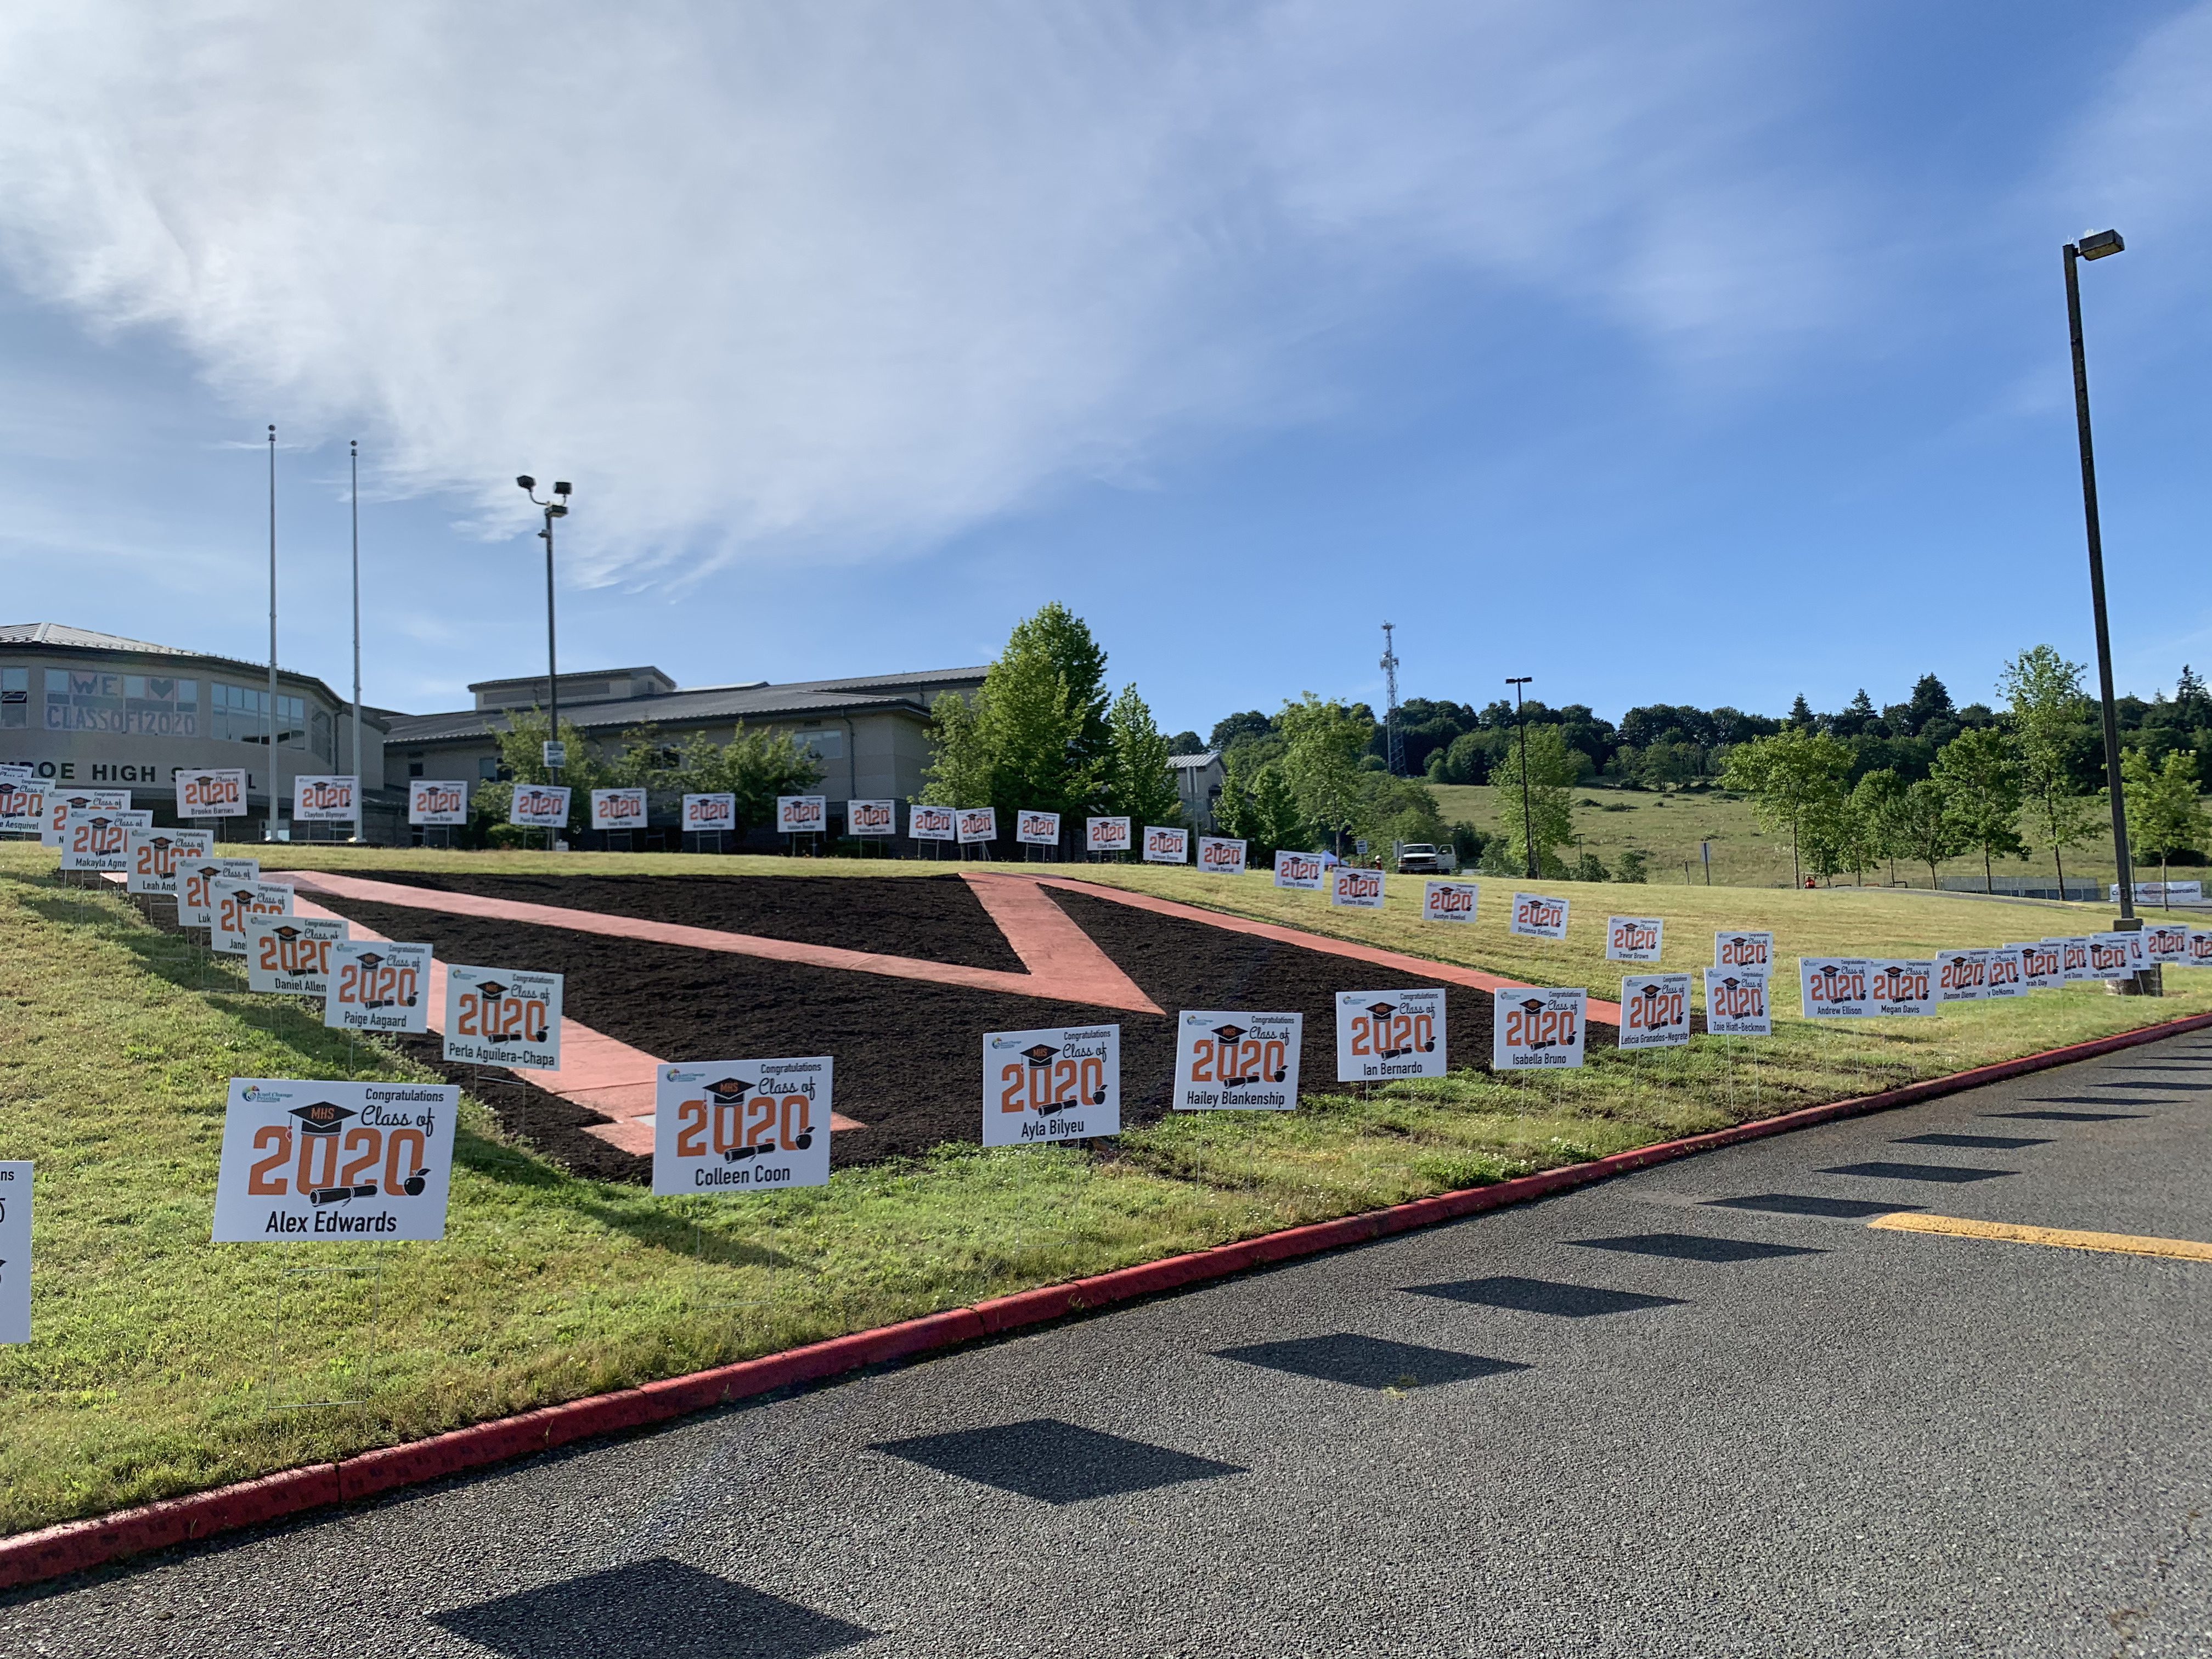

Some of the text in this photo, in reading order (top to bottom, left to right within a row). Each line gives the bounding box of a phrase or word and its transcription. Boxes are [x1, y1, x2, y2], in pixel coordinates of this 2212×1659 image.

[73, 672, 119, 695] WE
[92, 763, 155, 782] HIGH
[185, 782, 236, 804] 2020
[302, 788, 350, 808] 2020
[114, 799, 122, 809] of
[417, 793, 459, 812] 2020
[518, 796, 562, 815] 2020
[599, 800, 641, 818] 2020
[690, 804, 727, 820] 2020
[783, 805, 820, 822] 2020
[854, 809, 889, 825] 2020
[5, 820, 38, 830] Aesquivel
[114, 819, 134, 827] Class
[915, 815, 950, 831] 2020
[962, 817, 991, 833] 2020
[1023, 820, 1054, 835] 2020
[73, 826, 128, 853] 202
[1092, 826, 1125, 841] 2020
[175, 838, 205, 852] Class of
[1149, 837, 1182, 853] 2020
[76, 858, 106, 868] Makayla
[1204, 847, 1240, 865] 2020
[223, 868, 251, 880] Class of
[1280, 861, 1318, 880] 2020
[143, 881, 160, 891] Leah
[1339, 879, 1378, 898] 2020
[257, 893, 285, 910] Class of
[1430, 892, 1471, 911] 2020
[1518, 905, 1561, 928] 2020
[304, 928, 339, 940] Class of
[1614, 929, 1655, 950] 2020
[1762, 938, 1768, 947] of
[2148, 935, 2184, 953] 2020
[1723, 945, 1765, 964] 2020
[387, 954, 421, 974] Class of
[1841, 966, 1865, 978] Class of
[1905, 967, 1930, 979] Class of
[1940, 963, 1984, 988] 2020
[275, 978, 326, 992] Daniel Allen
[338, 964, 417, 1007] 2020
[1662, 984, 1685, 997] Class of
[1741, 978, 1763, 992] Class of
[1810, 975, 1864, 1001] 2020
[1873, 975, 1928, 1001] 2020
[511, 984, 551, 1006] Class of
[1400, 992, 1438, 1001] Congratulations
[1714, 987, 1761, 1016] 2020
[1944, 991, 1960, 1000] Damon
[1399, 1002, 1435, 1019] Class of
[1547, 1000, 1578, 1015] Class of
[1629, 994, 1683, 1029] 2020
[1817, 1006, 1862, 1015] Andrew Ellison
[1881, 1005, 1901, 1015] Megan
[345, 1011, 407, 1029] Paige Aagaard
[459, 994, 545, 1042] 2020
[1251, 1015, 1294, 1025] Congratulations
[1713, 1022, 1724, 1031] Zoie
[1064, 1030, 1111, 1042] Congratulations
[1249, 1026, 1290, 1046] Class of
[1351, 1015, 1432, 1056] 2020
[1506, 1011, 1575, 1046] 2020
[1621, 1032, 1688, 1045] Leticia Granados-Negrete
[449, 1042, 555, 1068] Perla Aguilera-Chapa
[1063, 1041, 1107, 1063] Class of
[1191, 1039, 1285, 1082] 2020
[1513, 1053, 1566, 1065] Isabella Bruno
[760, 1062, 822, 1075] Congratulations
[1363, 1061, 1422, 1076] Ian Bernardo
[759, 1076, 816, 1101] Class of
[1001, 1057, 1103, 1114] 2020
[365, 1088, 444, 1104] Congratulations
[1187, 1091, 1285, 1108] Hailey Blankenship
[311, 1107, 335, 1120] MHS
[361, 1105, 435, 1137] Class of
[676, 1094, 810, 1158] 2020
[1021, 1119, 1084, 1141] Ayla Bilyeu
[248, 1126, 425, 1196] 2020
[696, 1165, 791, 1187] Colleen Coon
[265, 1210, 397, 1233] Alex Edwards
